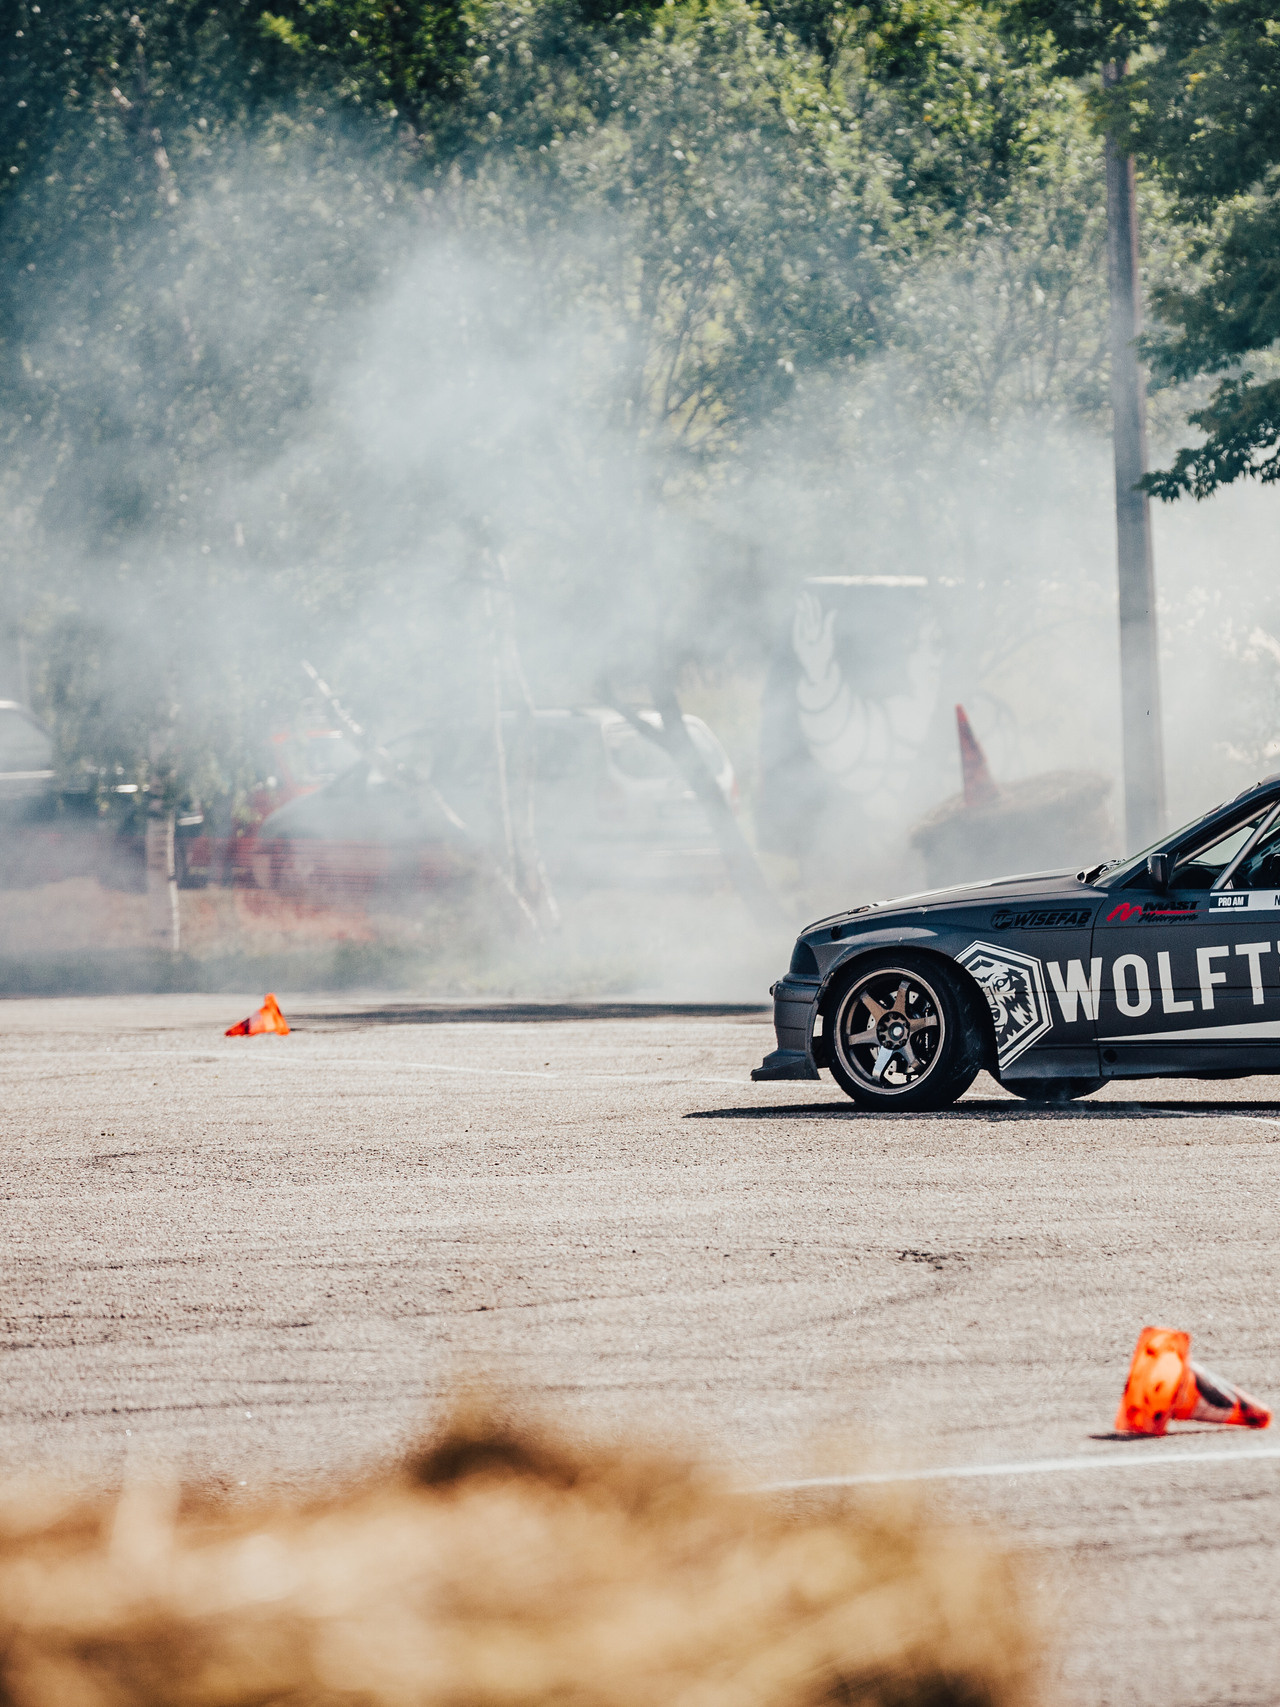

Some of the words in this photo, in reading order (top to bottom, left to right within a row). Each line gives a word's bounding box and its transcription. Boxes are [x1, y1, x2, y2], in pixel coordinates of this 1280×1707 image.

[1142, 900, 1200, 911] MAST
[1218, 896, 1231, 907] PRO
[1232, 896, 1244, 906] AM
[1013, 911, 1092, 927] WISEFAB
